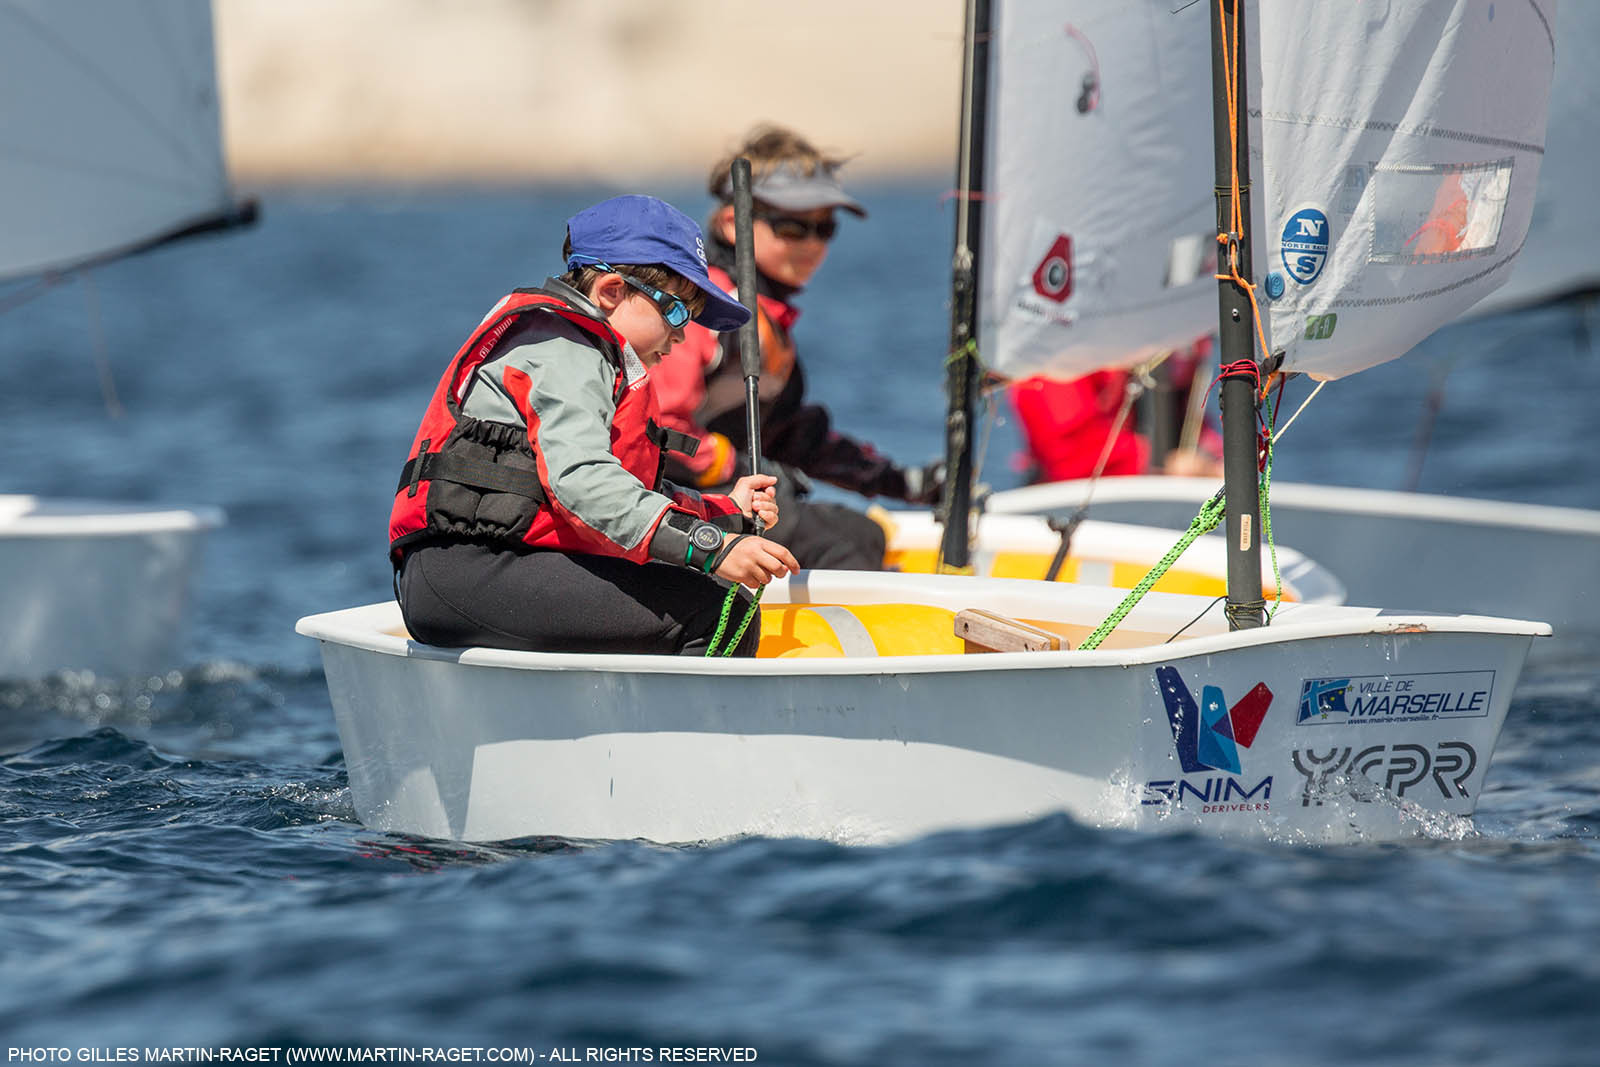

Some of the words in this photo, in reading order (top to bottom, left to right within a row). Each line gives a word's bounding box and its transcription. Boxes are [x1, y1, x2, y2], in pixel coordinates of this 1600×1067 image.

[1296, 218, 1324, 237] N
[1282, 241, 1312, 250] NORTH
[1296, 255, 1317, 275] S
[1359, 681, 1393, 693] VILLE
[1395, 680, 1415, 692] DE
[1350, 691, 1487, 716] MARSEILLE
[1141, 775, 1273, 805] SNIM
